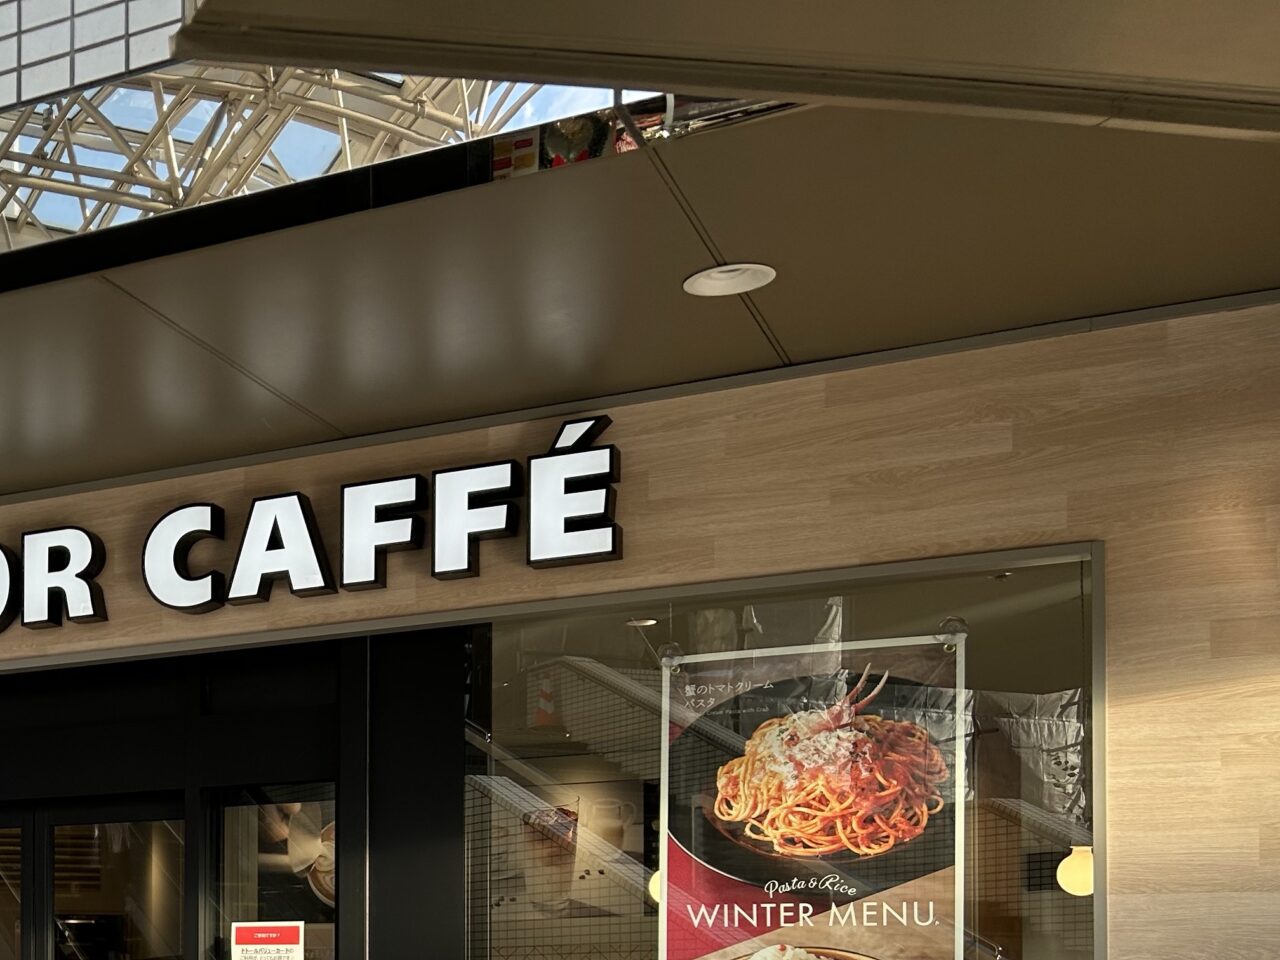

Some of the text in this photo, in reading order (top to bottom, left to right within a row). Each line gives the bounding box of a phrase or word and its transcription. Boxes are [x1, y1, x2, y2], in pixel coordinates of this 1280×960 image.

[142, 416, 622, 613] CAFFÉ
[684, 679, 775, 697] 蟹のトマトクリーム
[764, 877, 806, 898] Pasta
[819, 874, 857, 896] Rice
[687, 901, 934, 928] WINTER MENU
